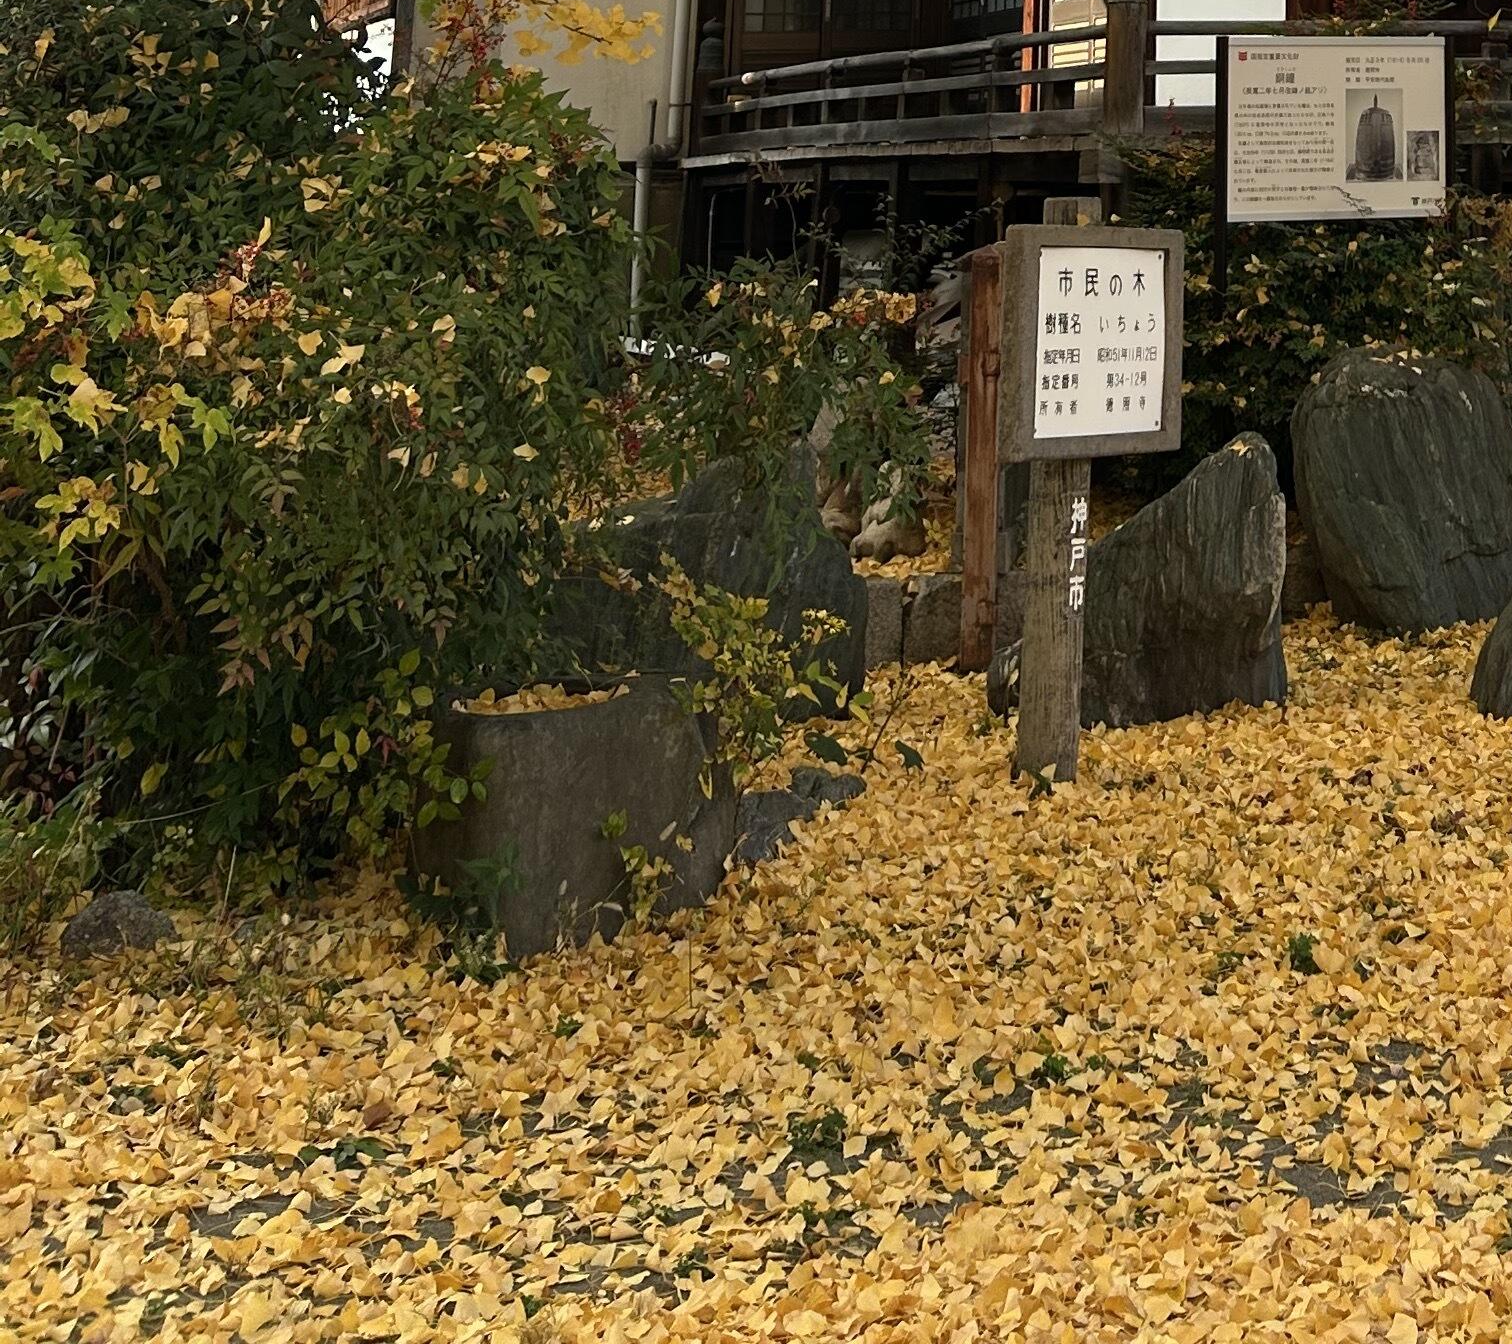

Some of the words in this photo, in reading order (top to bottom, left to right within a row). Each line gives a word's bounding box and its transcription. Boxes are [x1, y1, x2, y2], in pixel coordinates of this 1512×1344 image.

[1058, 267, 1146, 297] 市民の木
[1045, 312, 1081, 335] 樹種名
[1099, 313, 1156, 333] いちょう
[1043, 348, 1081, 364] 指定年月日
[1041, 373, 1079, 390] 指定番号
[1038, 399, 1079, 416] 所有者
[1069, 496, 1088, 611] 神戸市
